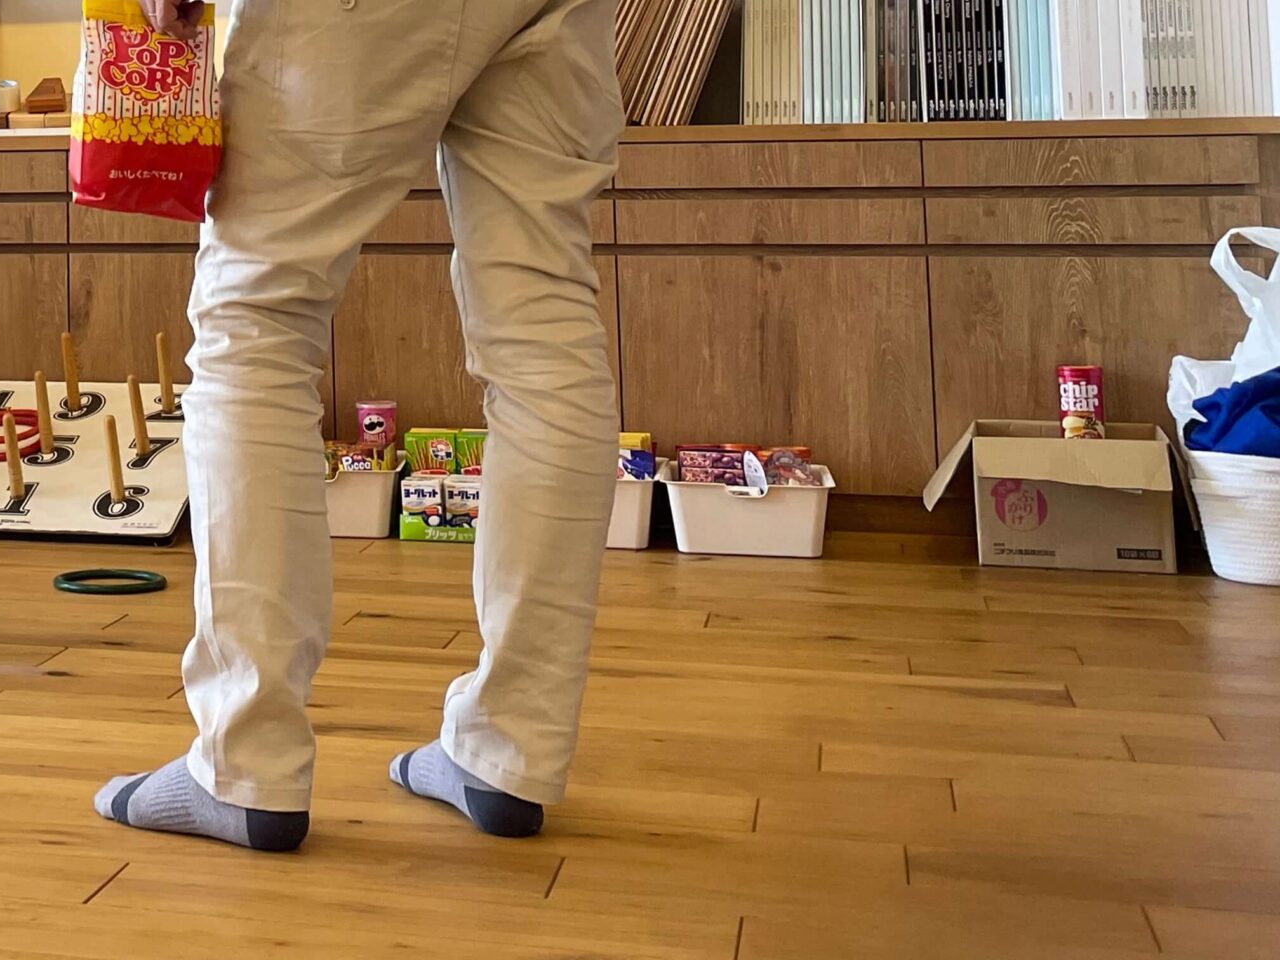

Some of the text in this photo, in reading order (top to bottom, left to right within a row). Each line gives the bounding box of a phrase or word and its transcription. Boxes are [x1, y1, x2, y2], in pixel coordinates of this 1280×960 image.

[1059, 381, 1098, 400] chip
[53, 391, 107, 422] 9
[1060, 396, 1099, 412] star
[22, 434, 80, 466] 5
[126, 437, 180, 470] 7
[342, 456, 371, 470] Pucca
[92, 485, 150, 520] 6
[404, 488, 438, 498] ヨーグレット
[425, 528, 457, 540] プリッツ
